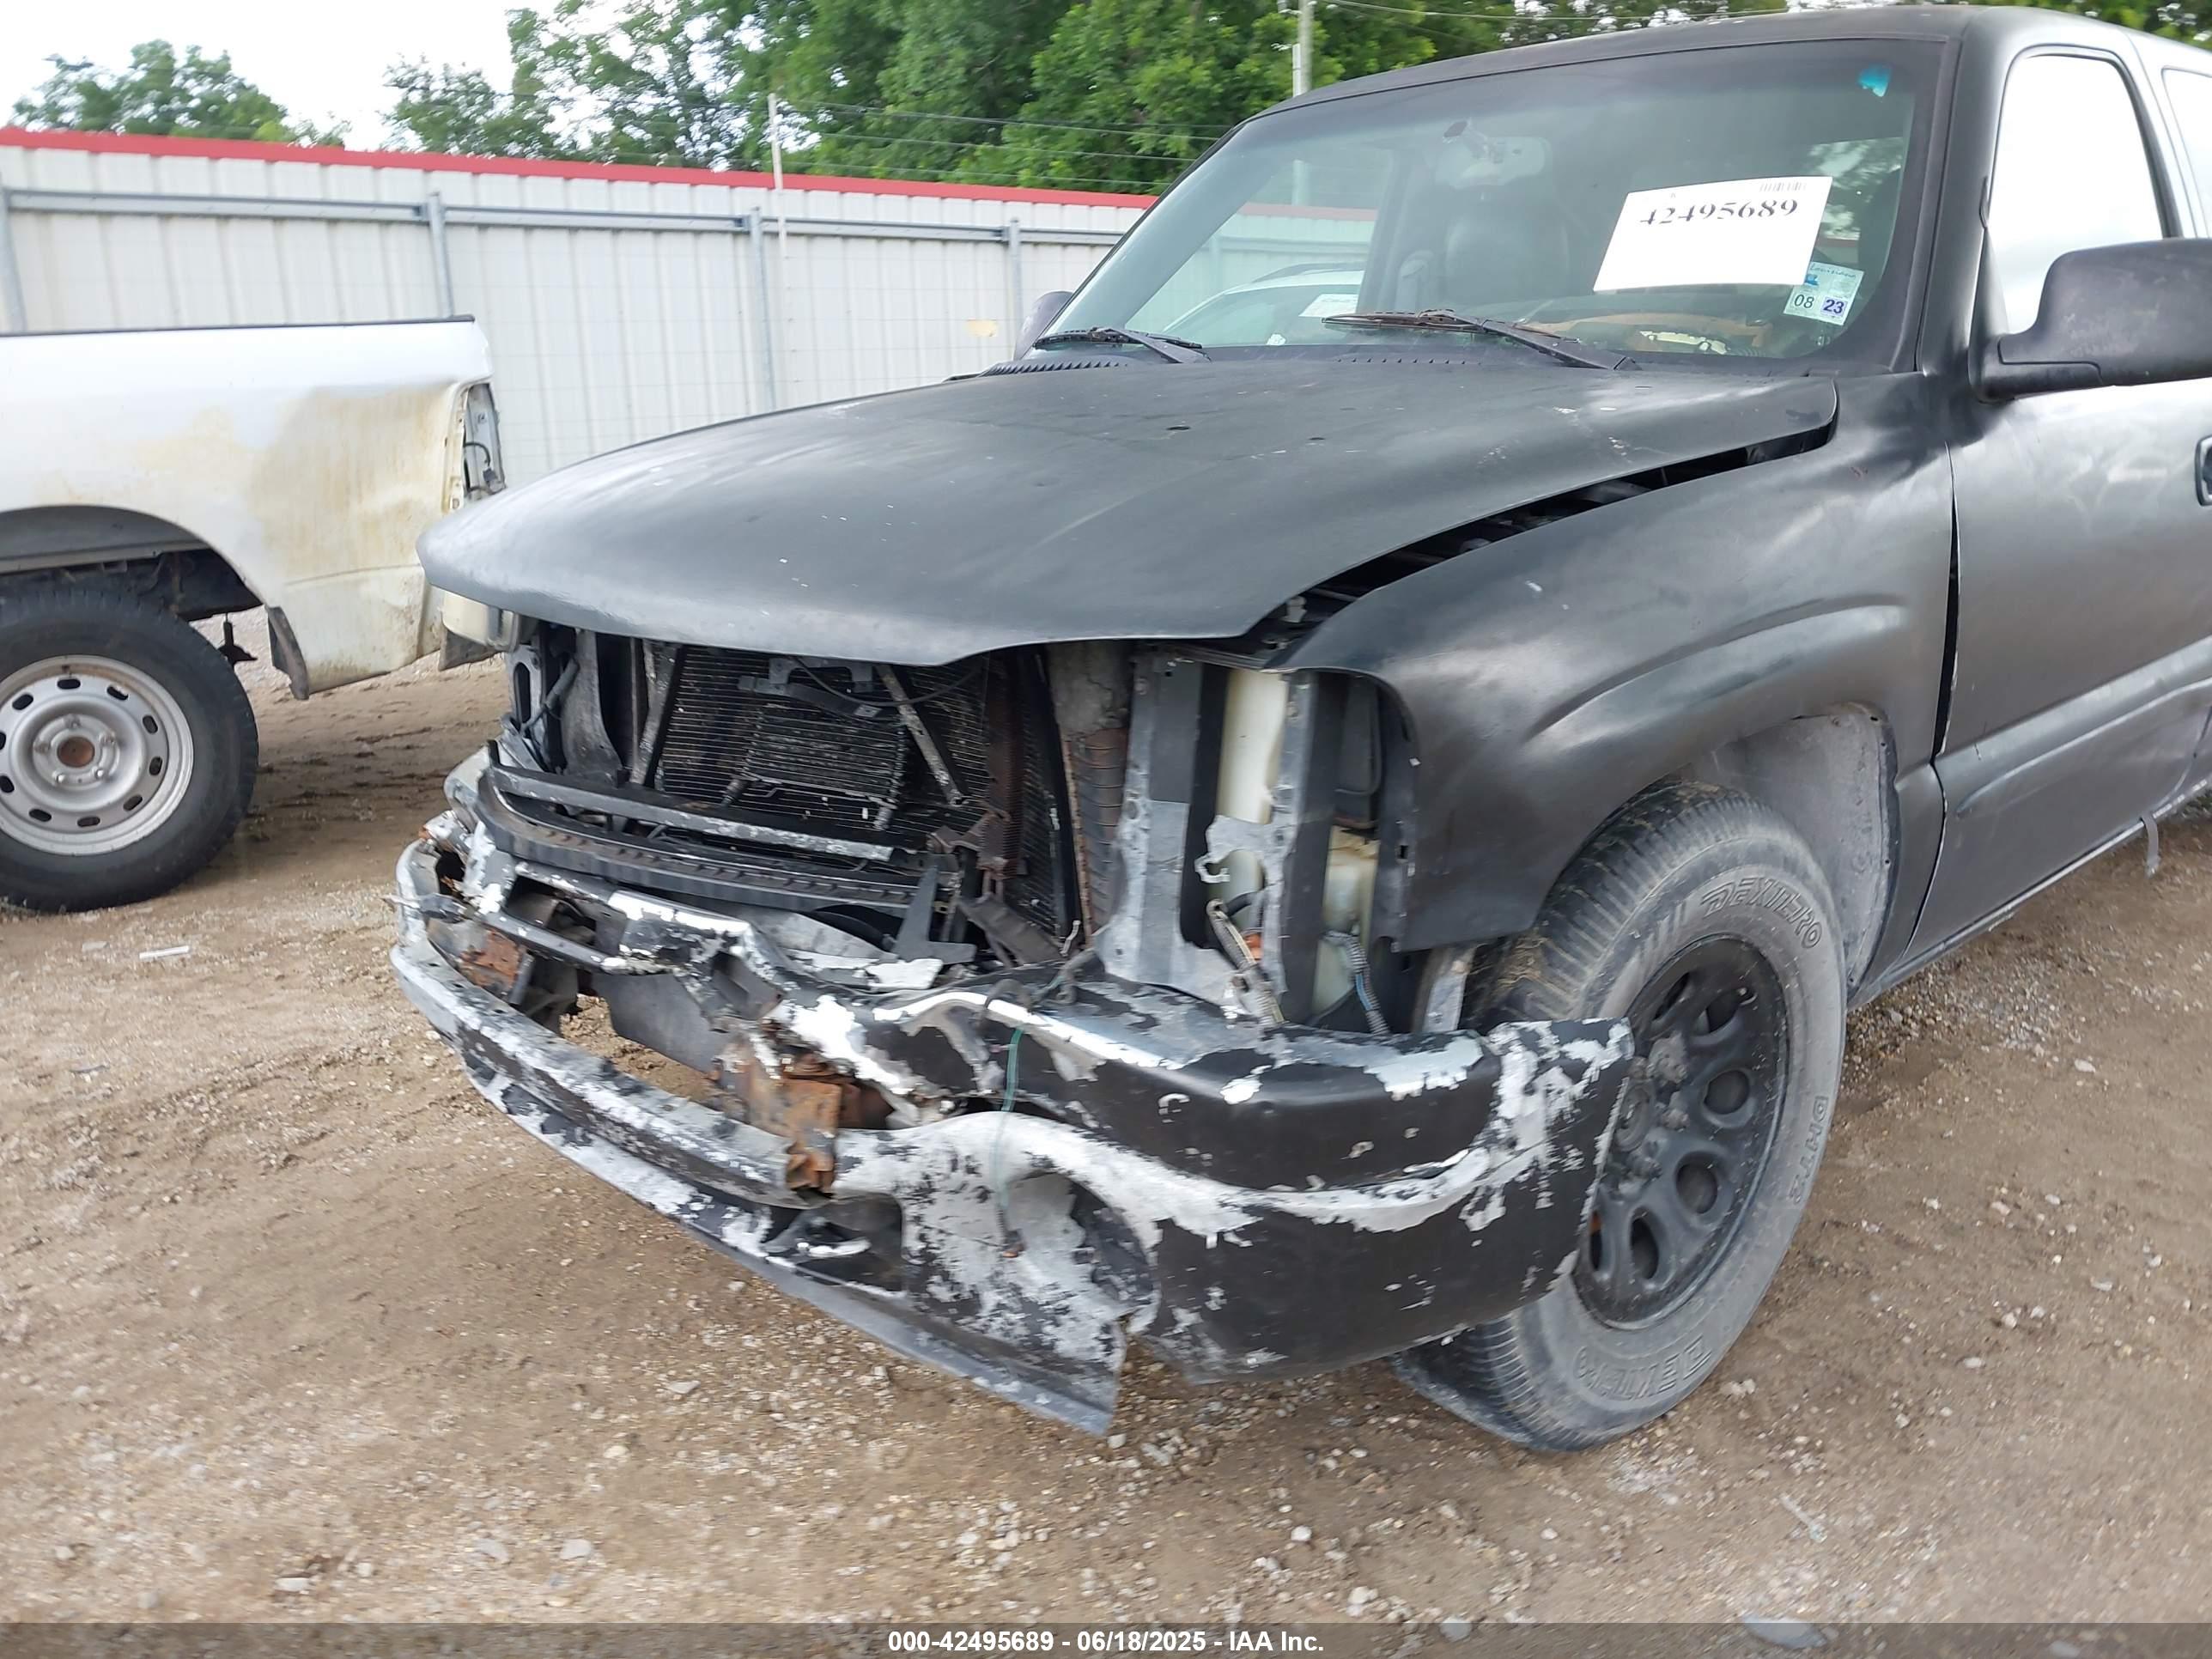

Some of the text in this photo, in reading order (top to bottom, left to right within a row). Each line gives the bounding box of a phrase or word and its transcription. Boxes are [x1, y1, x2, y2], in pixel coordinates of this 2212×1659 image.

[1639, 198, 1798, 226] 42495689
[1793, 294, 1844, 314] 08 23
